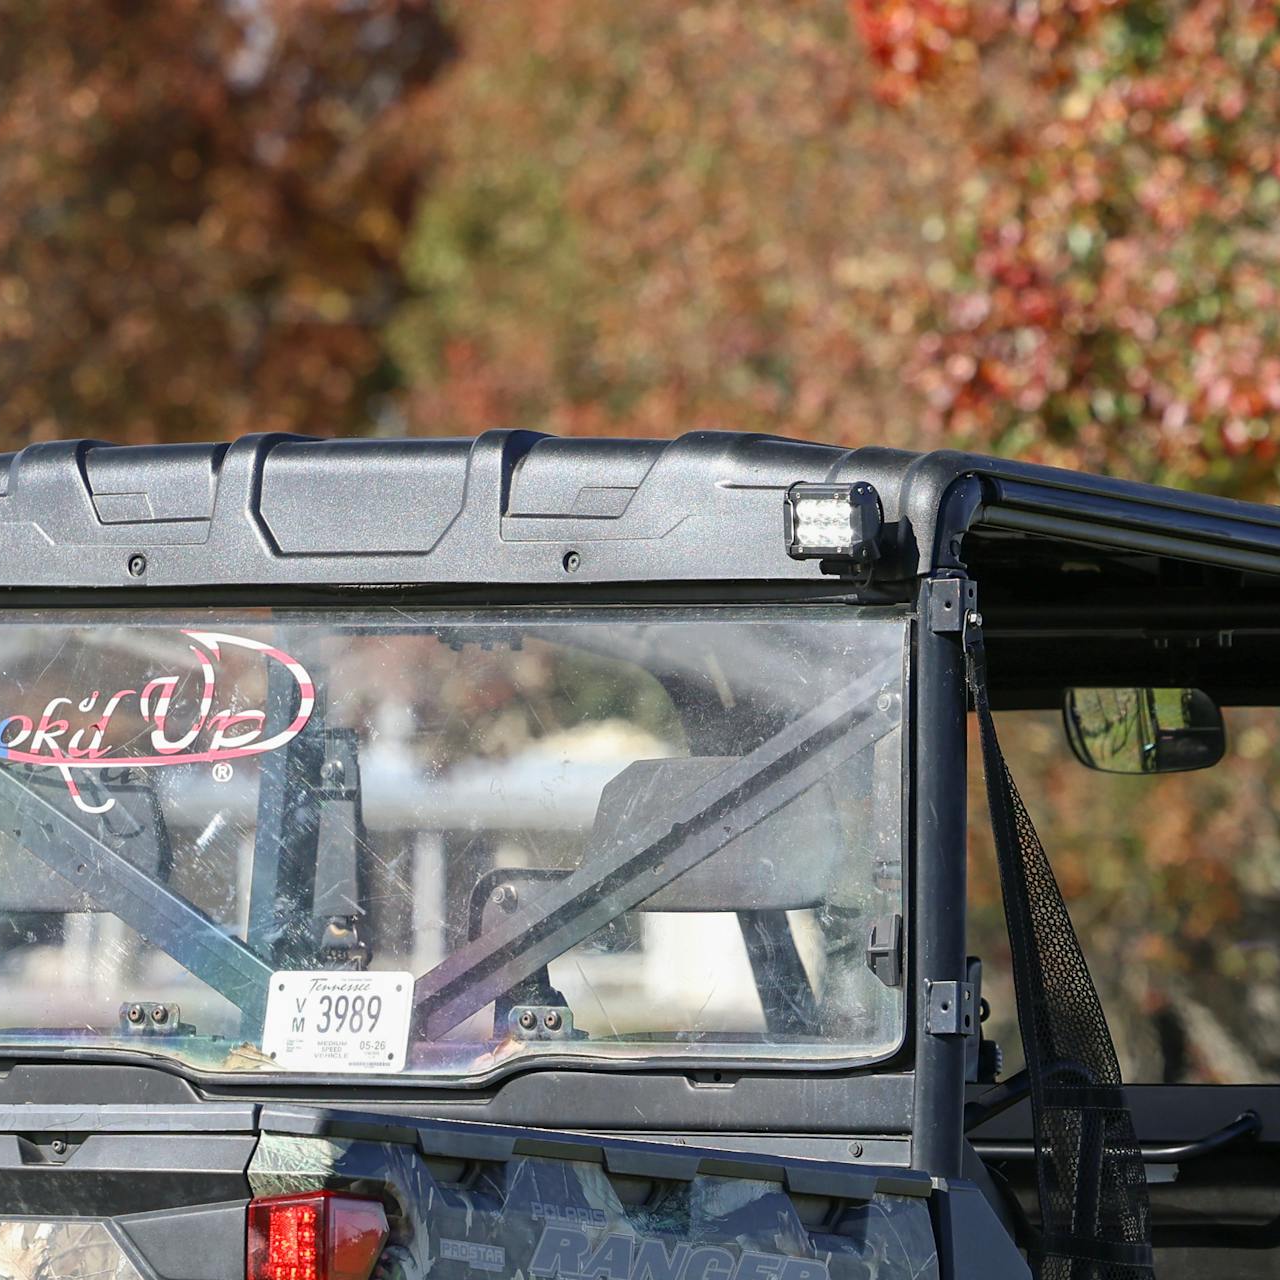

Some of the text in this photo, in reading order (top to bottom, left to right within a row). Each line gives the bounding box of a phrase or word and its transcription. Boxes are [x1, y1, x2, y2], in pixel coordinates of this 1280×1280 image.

[309, 977, 371, 993] Tennessee
[296, 995, 382, 1034] V 3989
[291, 1017, 305, 1033] M
[359, 1040, 386, 1050] 05-26
[530, 1201, 607, 1228] POLARIS
